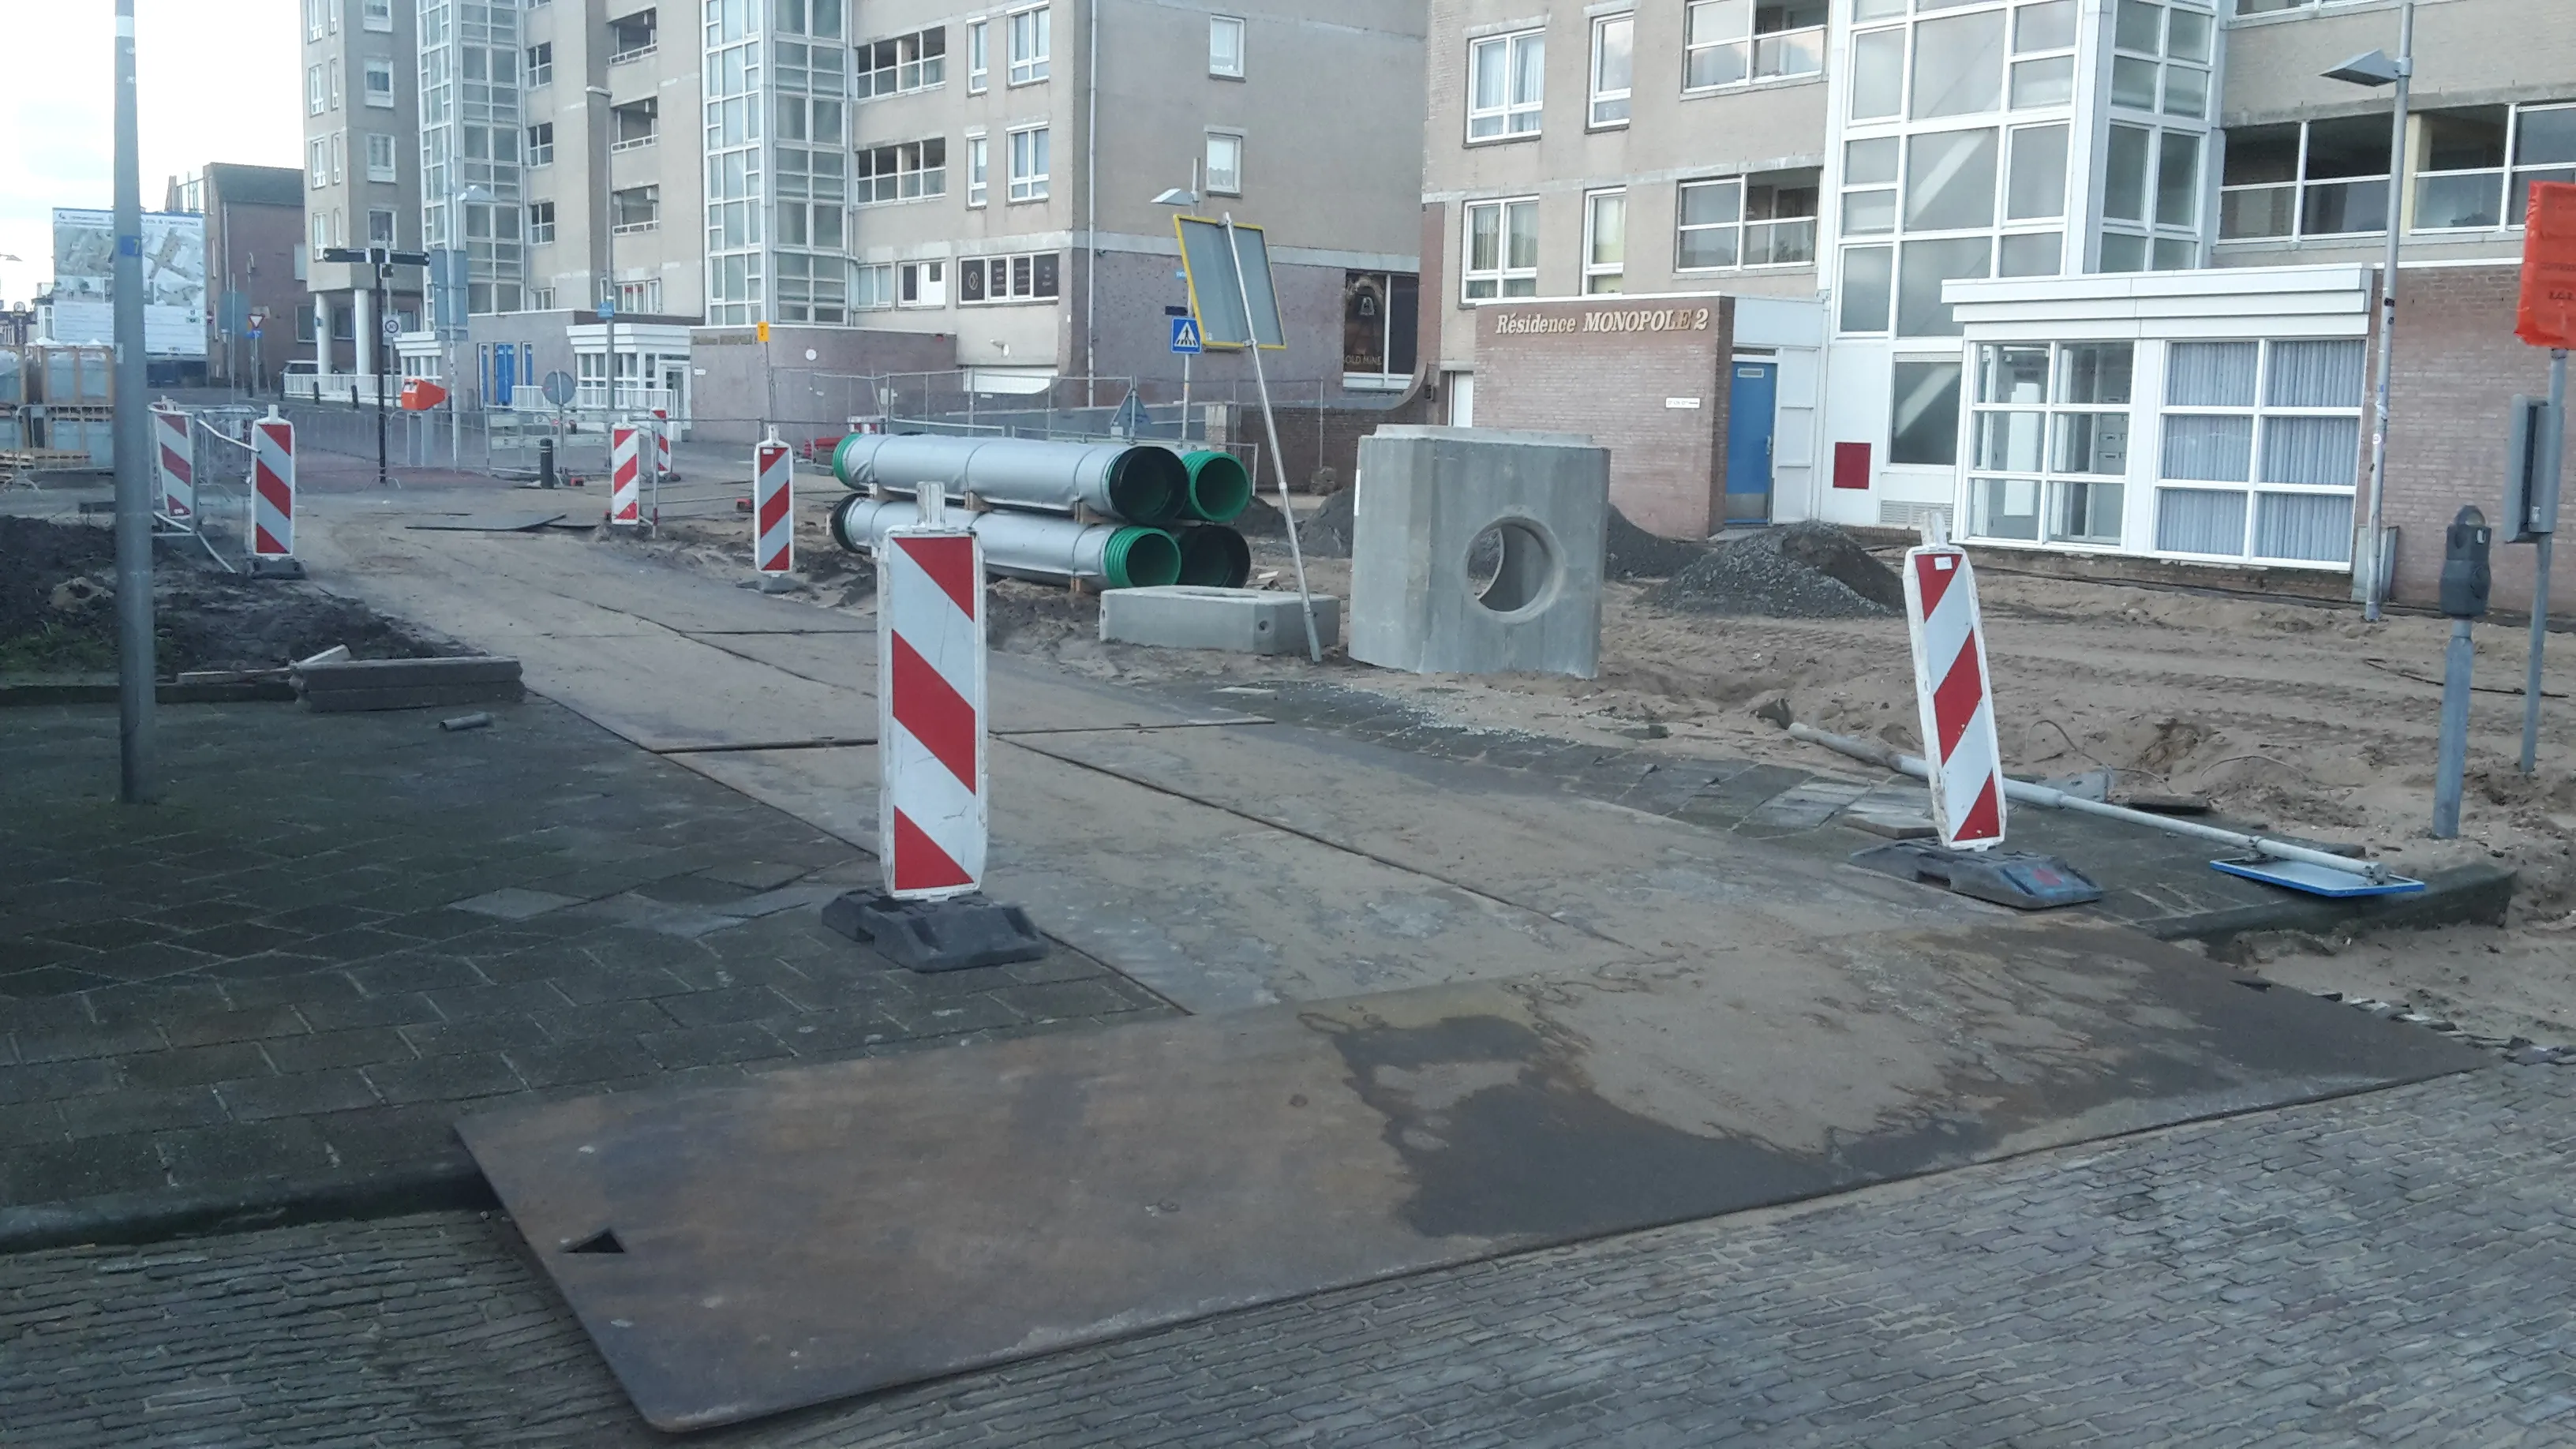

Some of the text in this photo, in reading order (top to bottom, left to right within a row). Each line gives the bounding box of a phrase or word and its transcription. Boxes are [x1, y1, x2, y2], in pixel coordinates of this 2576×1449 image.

[1496, 307, 1709, 335] Résidence MONOPOLE 2
[1345, 355, 1382, 365] OLD MINE
